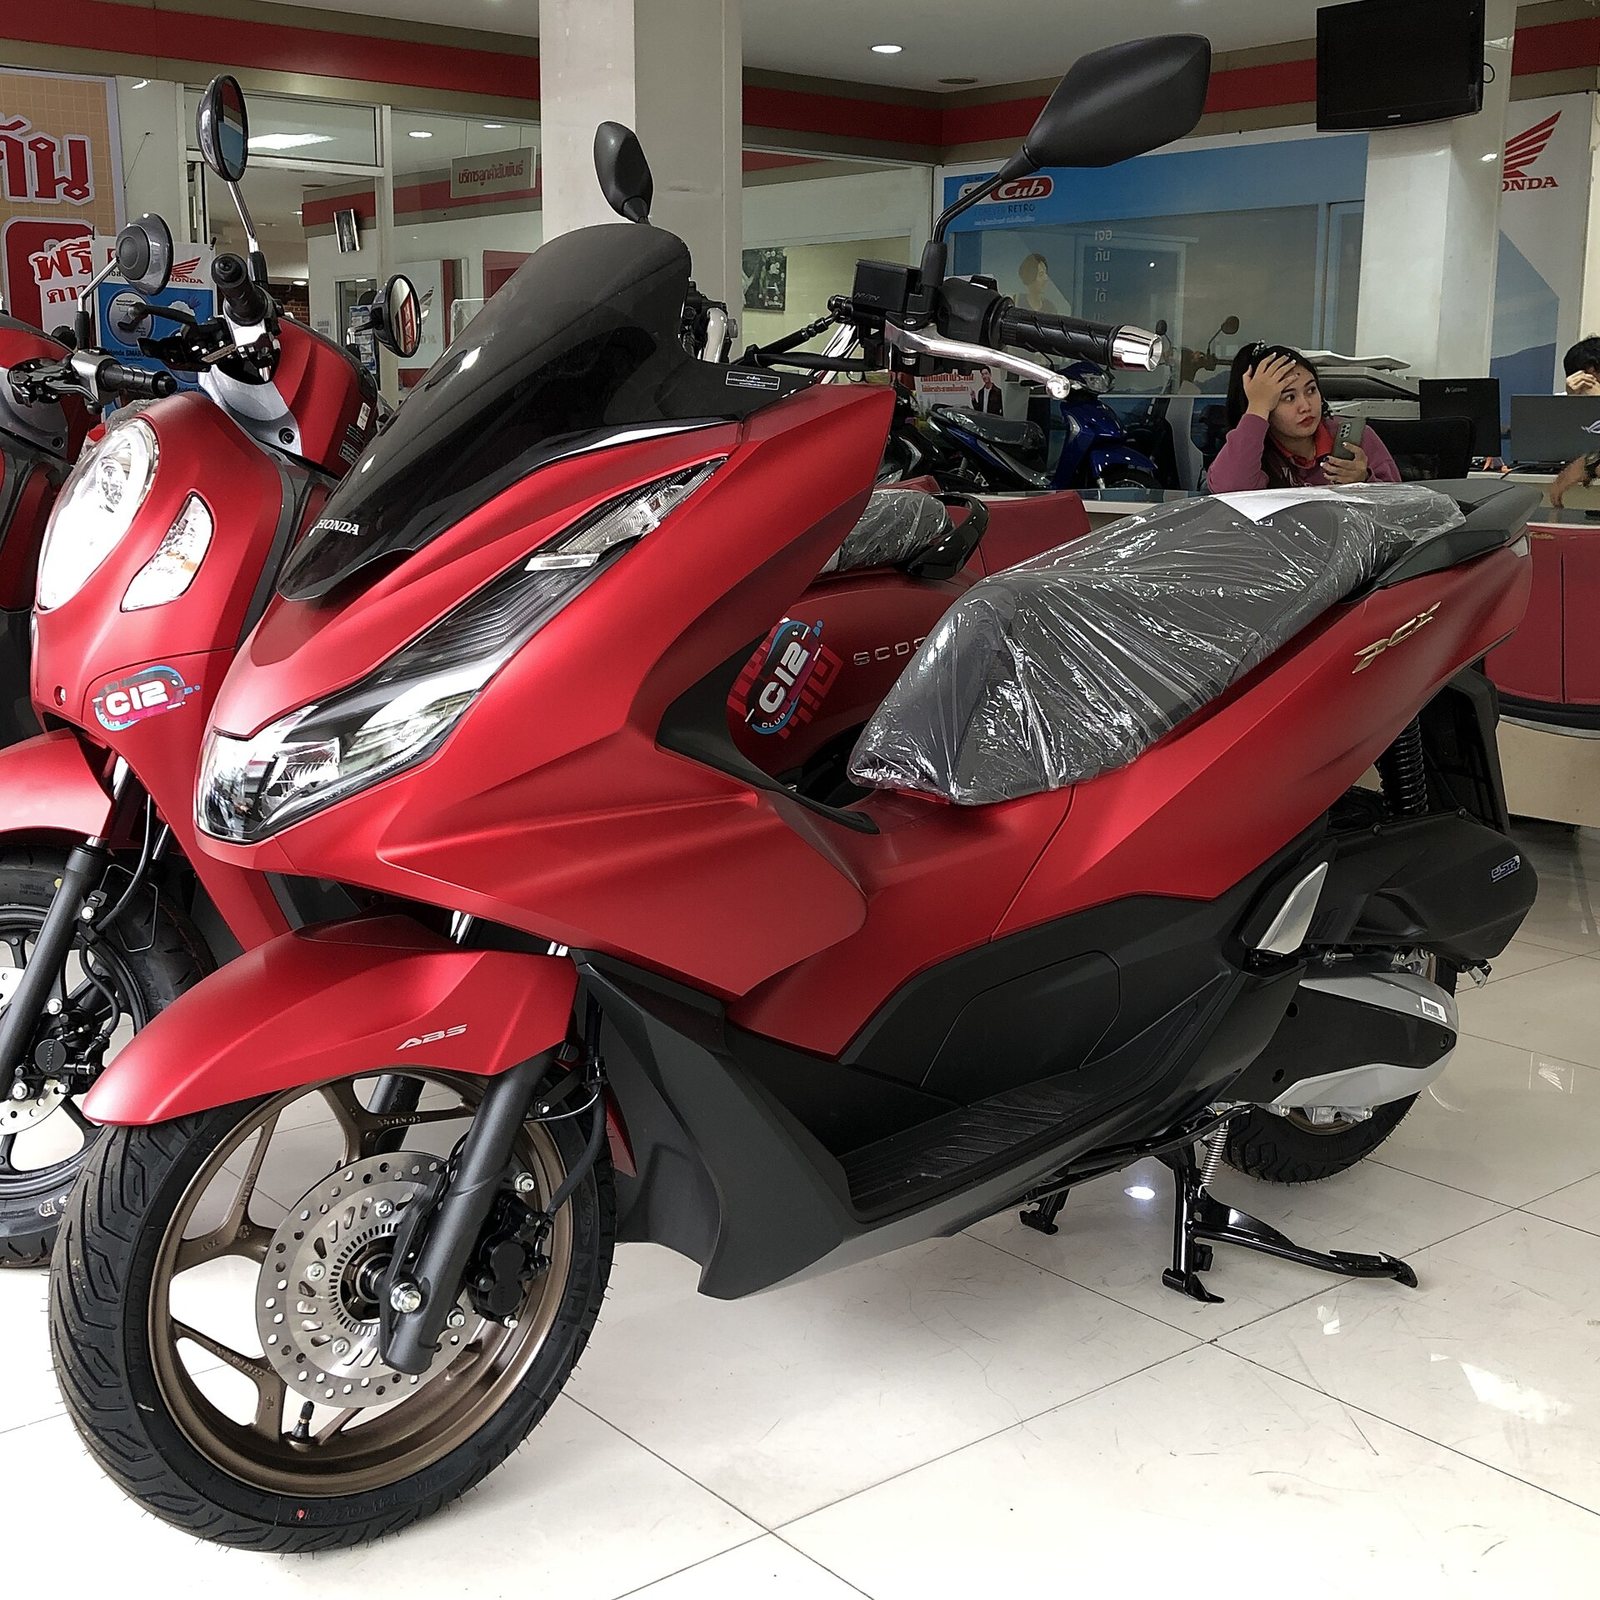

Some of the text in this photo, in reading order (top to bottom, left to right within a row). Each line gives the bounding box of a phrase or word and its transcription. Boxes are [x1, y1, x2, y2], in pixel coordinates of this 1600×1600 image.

[998, 180, 1044, 199] Cub
[1502, 176, 1559, 192] ONDA
[1007, 204, 1036, 213] RETRO
[316, 518, 360, 536] HONDA
[1351, 600, 1442, 674] PCX
[761, 712, 786, 729] CLUB
[395, 1023, 468, 1052] ABS
